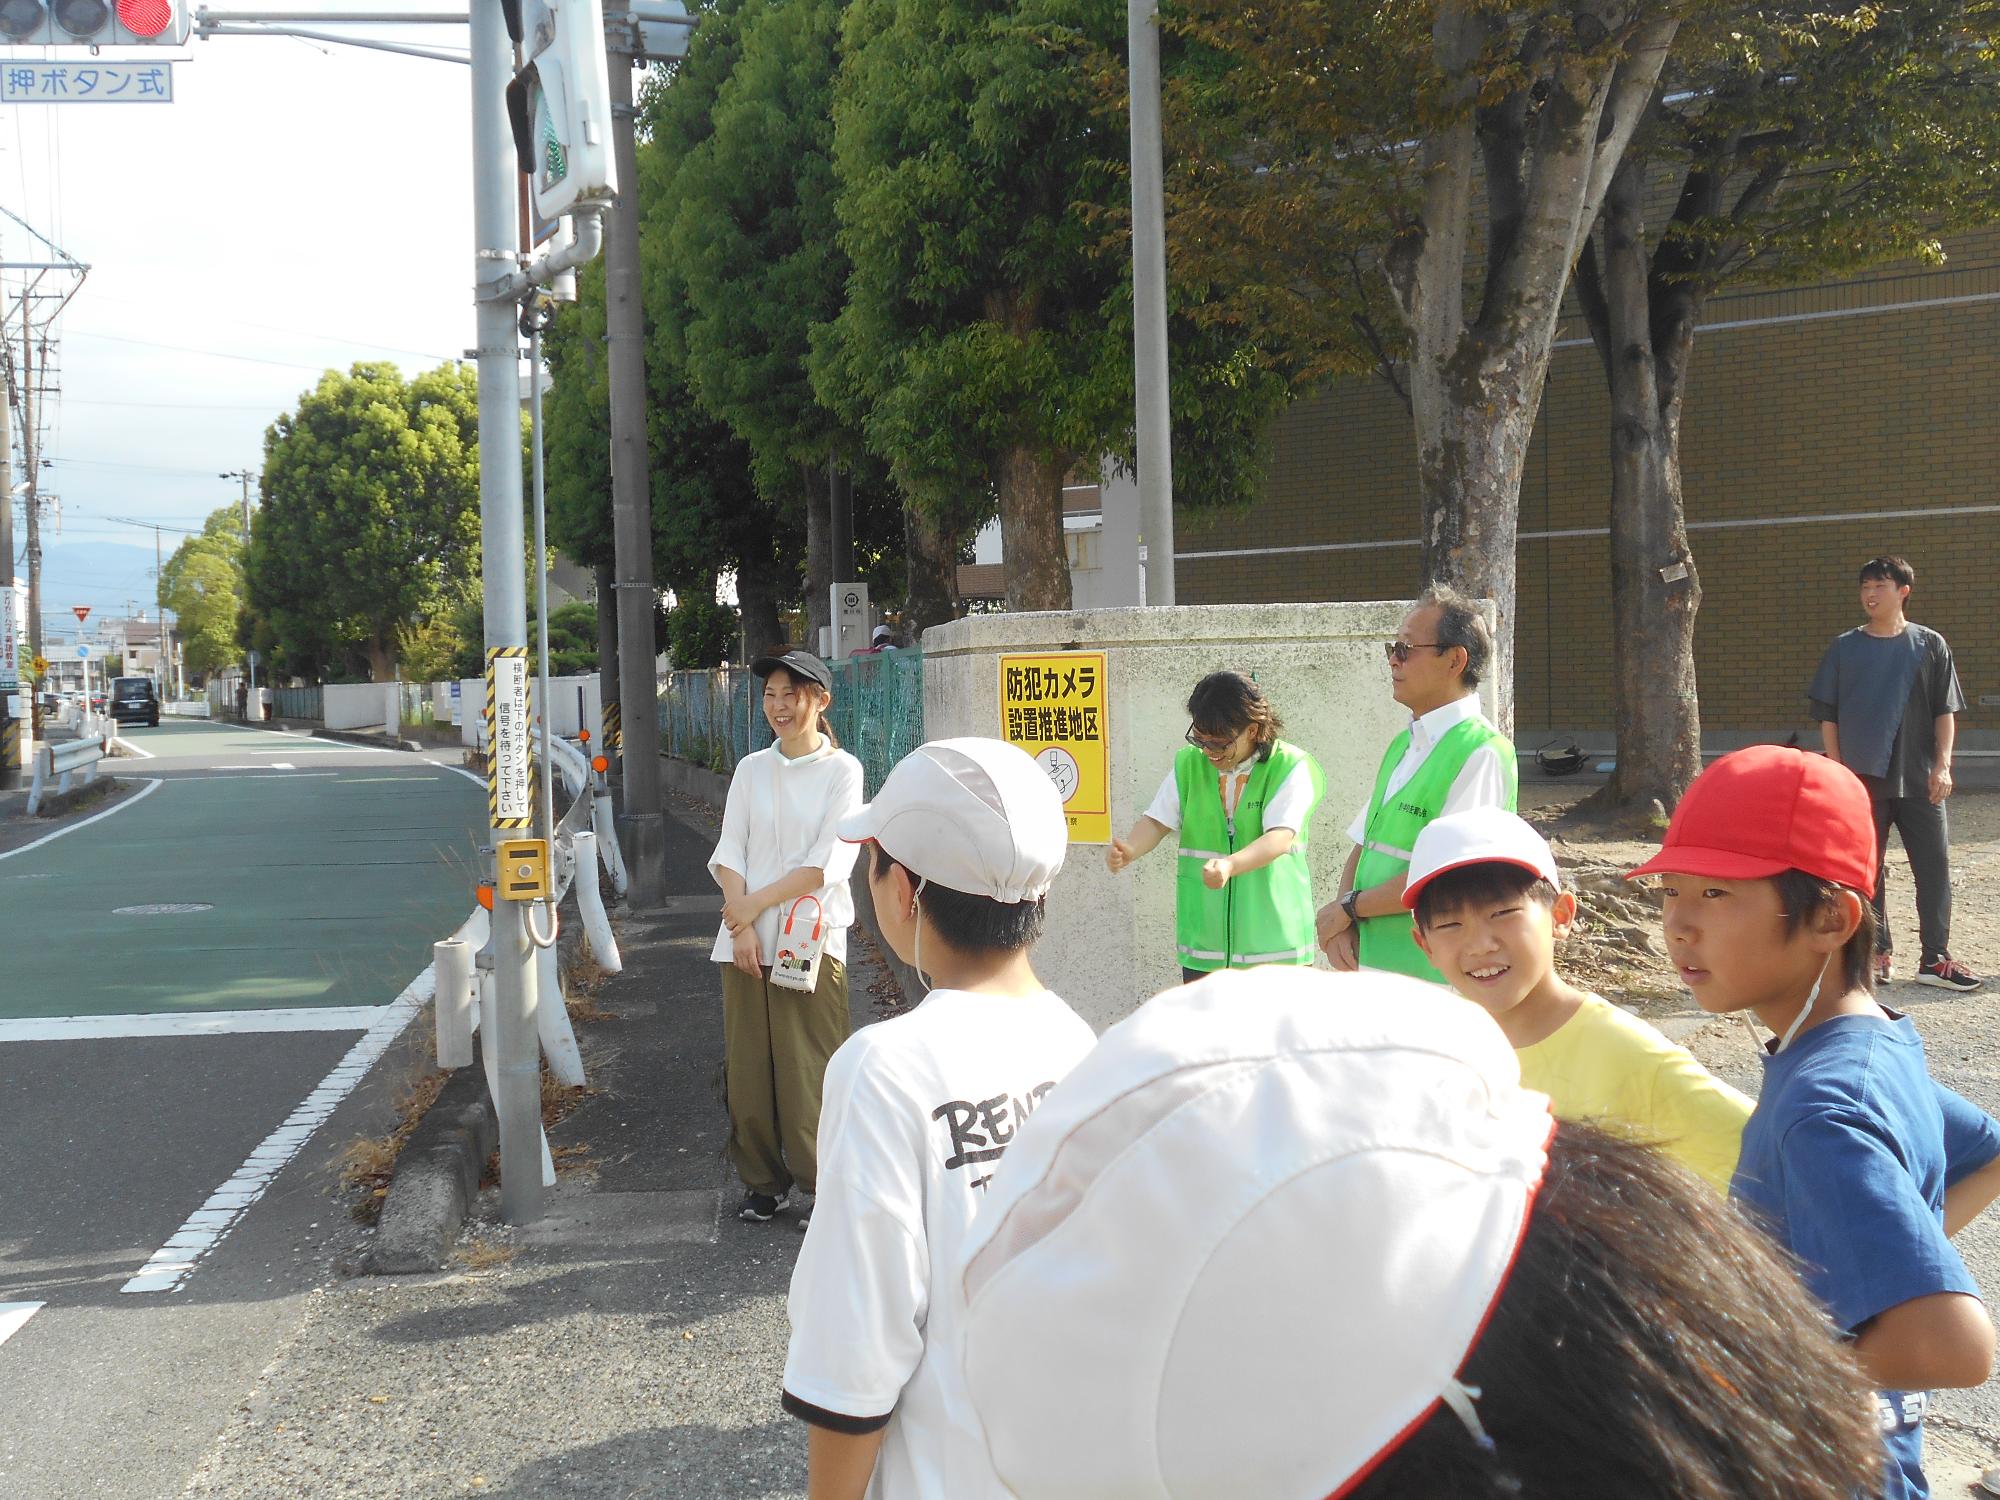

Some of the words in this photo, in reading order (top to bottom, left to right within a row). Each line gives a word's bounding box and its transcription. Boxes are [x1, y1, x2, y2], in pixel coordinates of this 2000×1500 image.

[8, 68, 164, 95] 押ボタン式
[1006, 666, 1096, 702] 防犯カメラ
[1007, 706, 1100, 742] 設置推進地区
[499, 702, 513, 813] 信号を待って下さい
